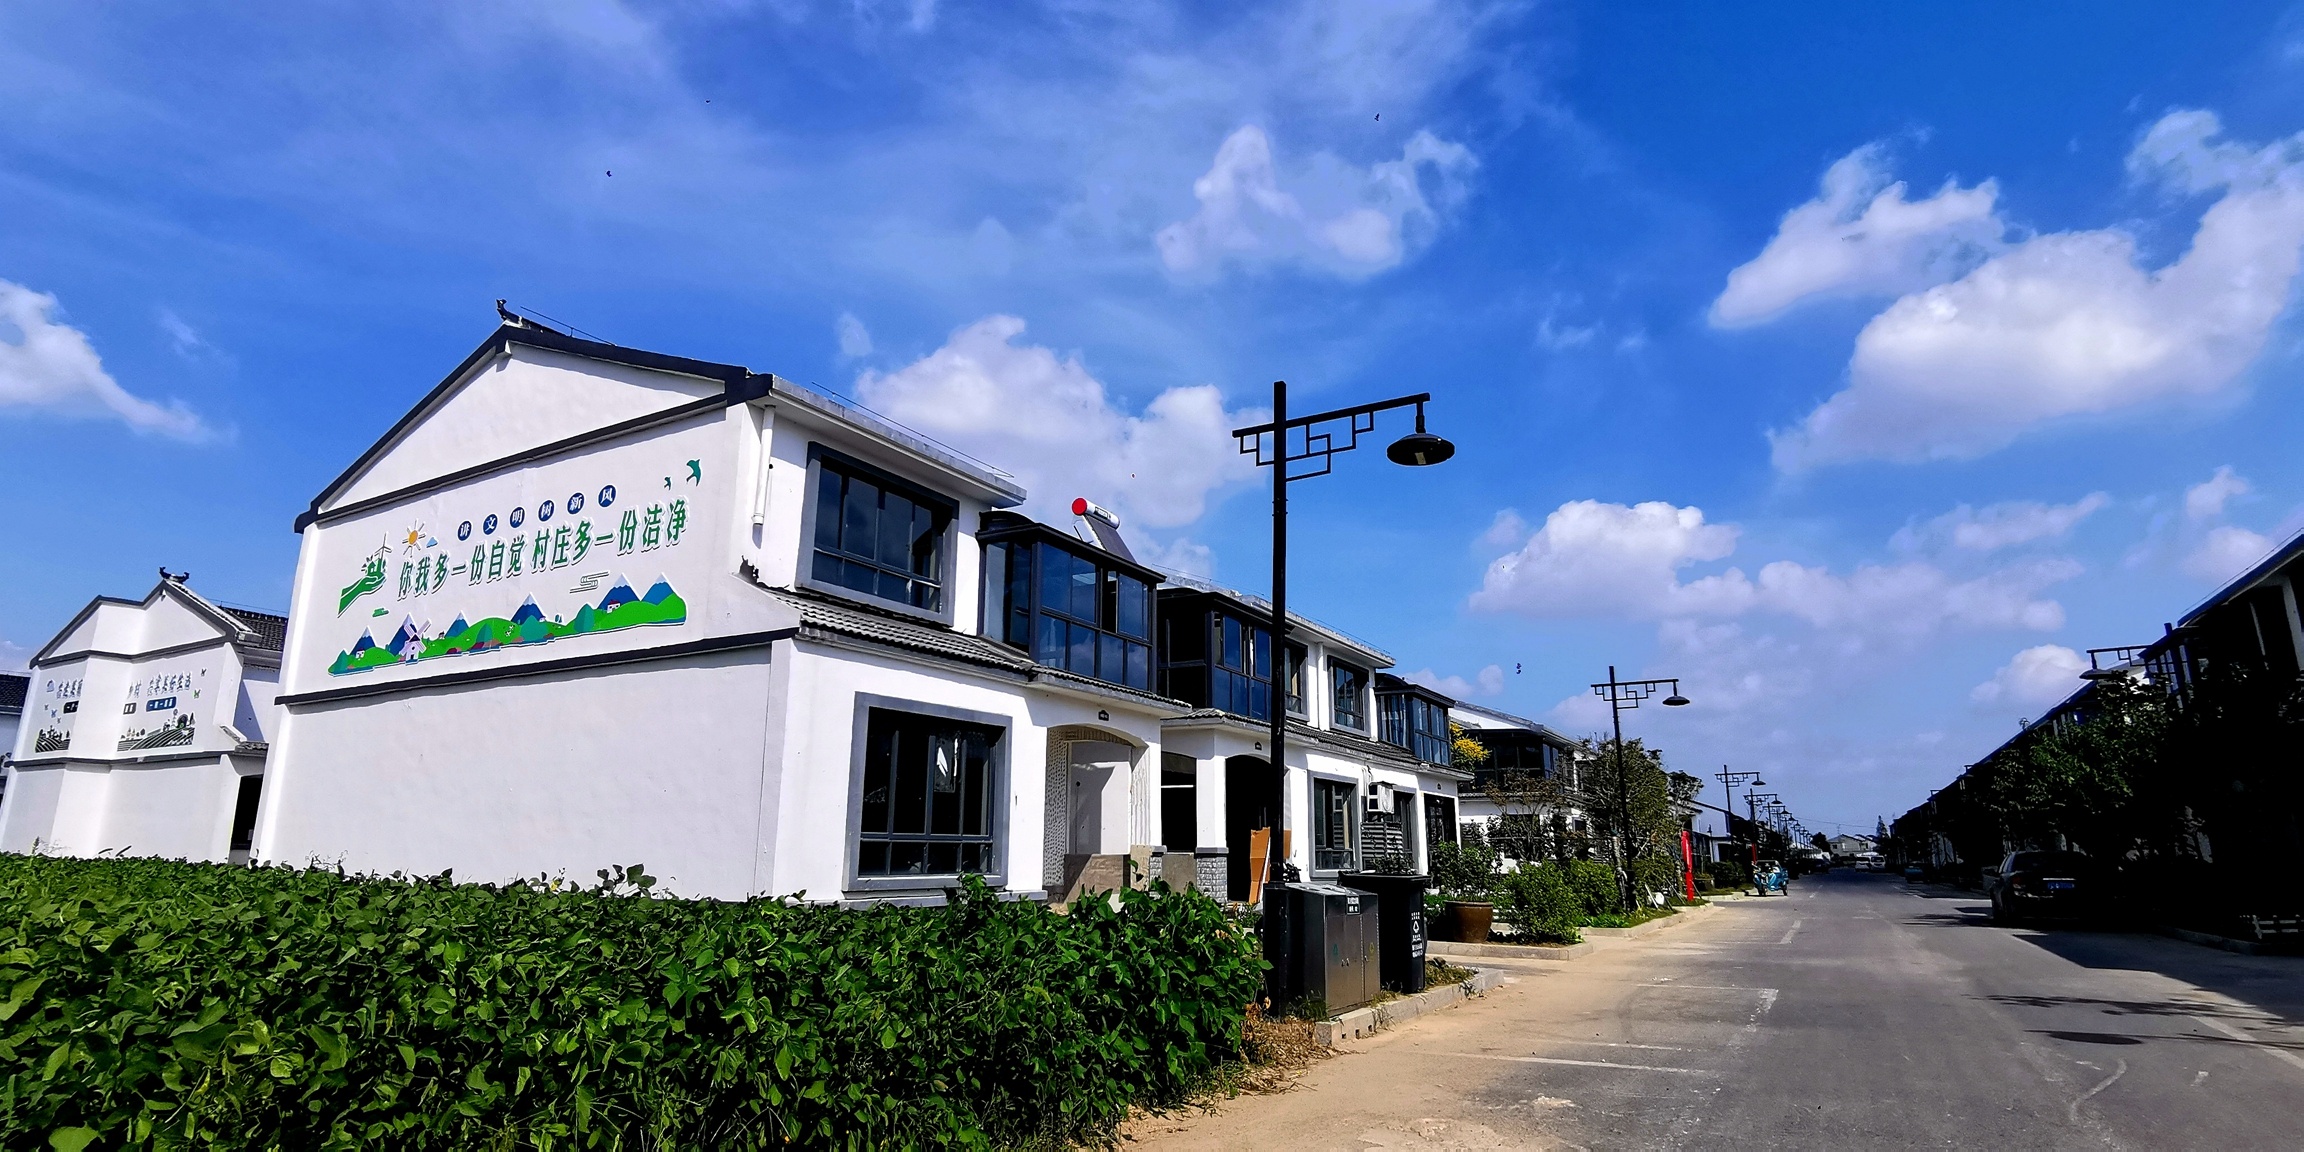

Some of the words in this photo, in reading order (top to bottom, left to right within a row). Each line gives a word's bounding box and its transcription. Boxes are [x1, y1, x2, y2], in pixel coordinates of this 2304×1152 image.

[398, 534, 526, 601] 你我多一份自觉
[531, 498, 688, 574] 村庄多一份洁净
[459, 487, 615, 538] 讲文明树新风
